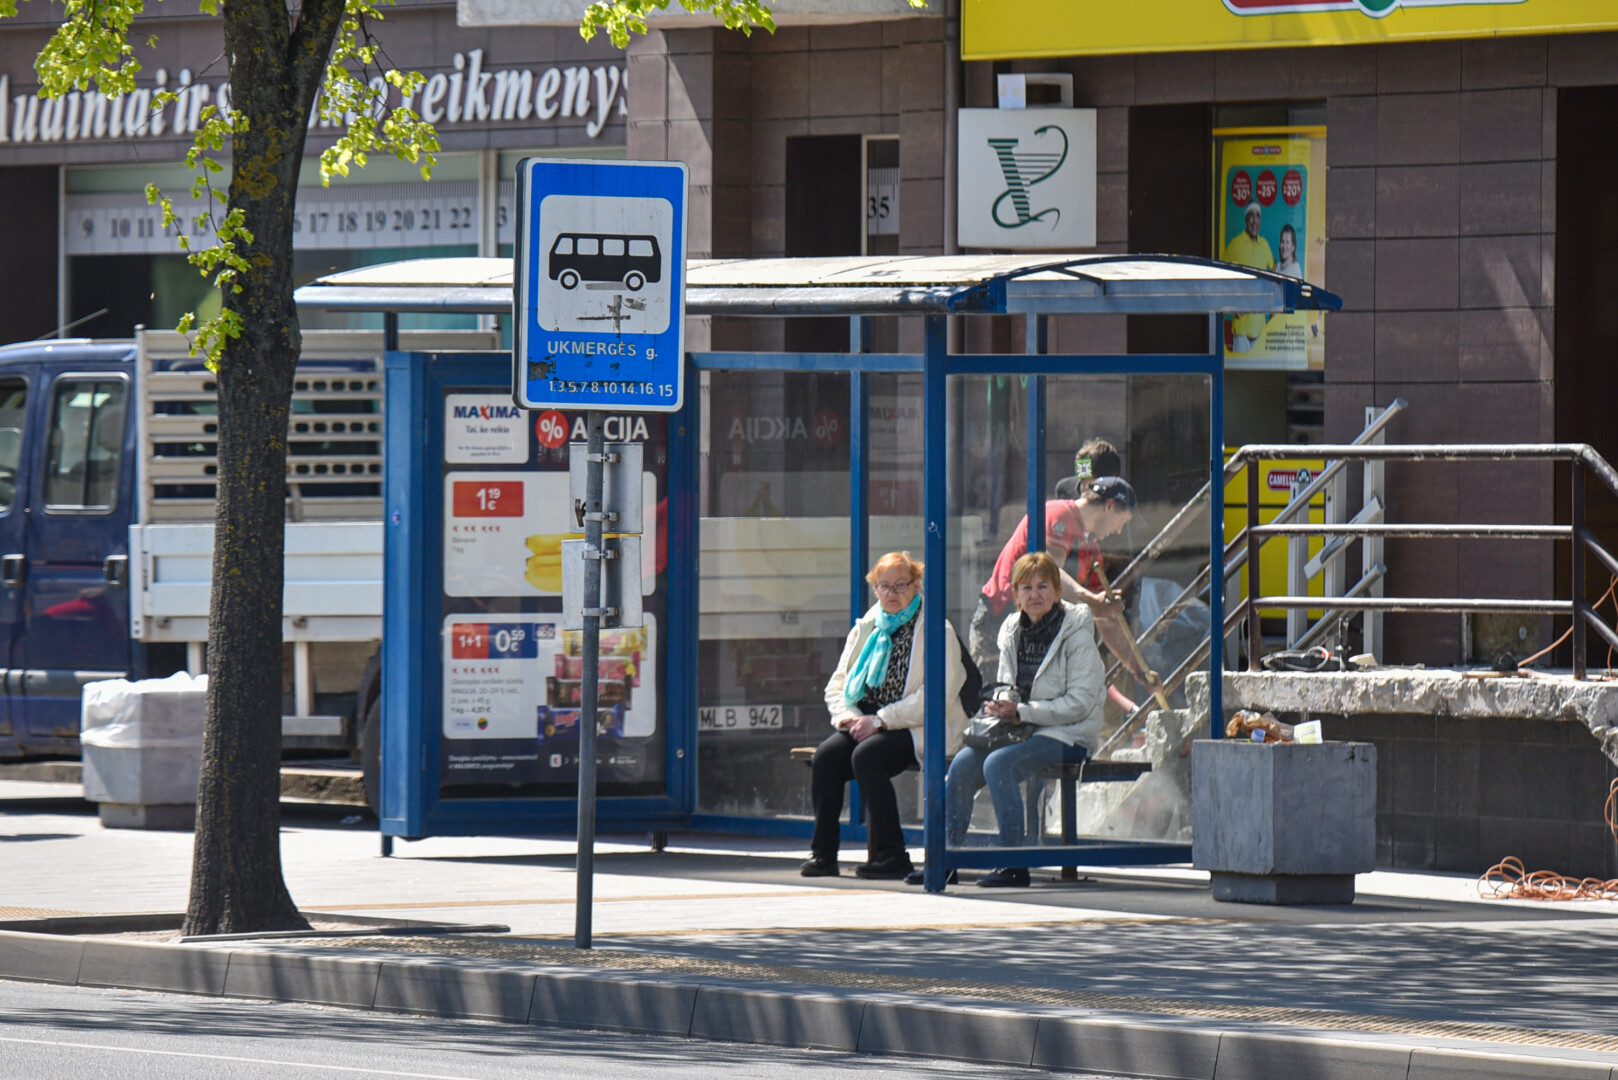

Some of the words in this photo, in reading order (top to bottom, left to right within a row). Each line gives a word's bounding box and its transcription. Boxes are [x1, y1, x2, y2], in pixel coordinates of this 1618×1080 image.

[173, 68, 210, 135] ir
[867, 196, 890, 219] 35
[82, 217, 94, 237] 9
[111, 217, 130, 238] 10
[138, 217, 154, 237] 11
[309, 212, 329, 233] 17
[337, 211, 358, 232] 18
[365, 210, 386, 232] 19
[393, 208, 414, 231] 20
[420, 208, 440, 230] 21
[449, 207, 471, 229] 22
[547, 340, 637, 356] UKMERGĖS
[645, 347, 658, 360] g.
[453, 404, 521, 420] MAXIMA
[570, 416, 650, 443] ACIJA
[458, 634, 482, 648] 1+1
[700, 708, 737, 728] MLB
[749, 706, 779, 727] 942
